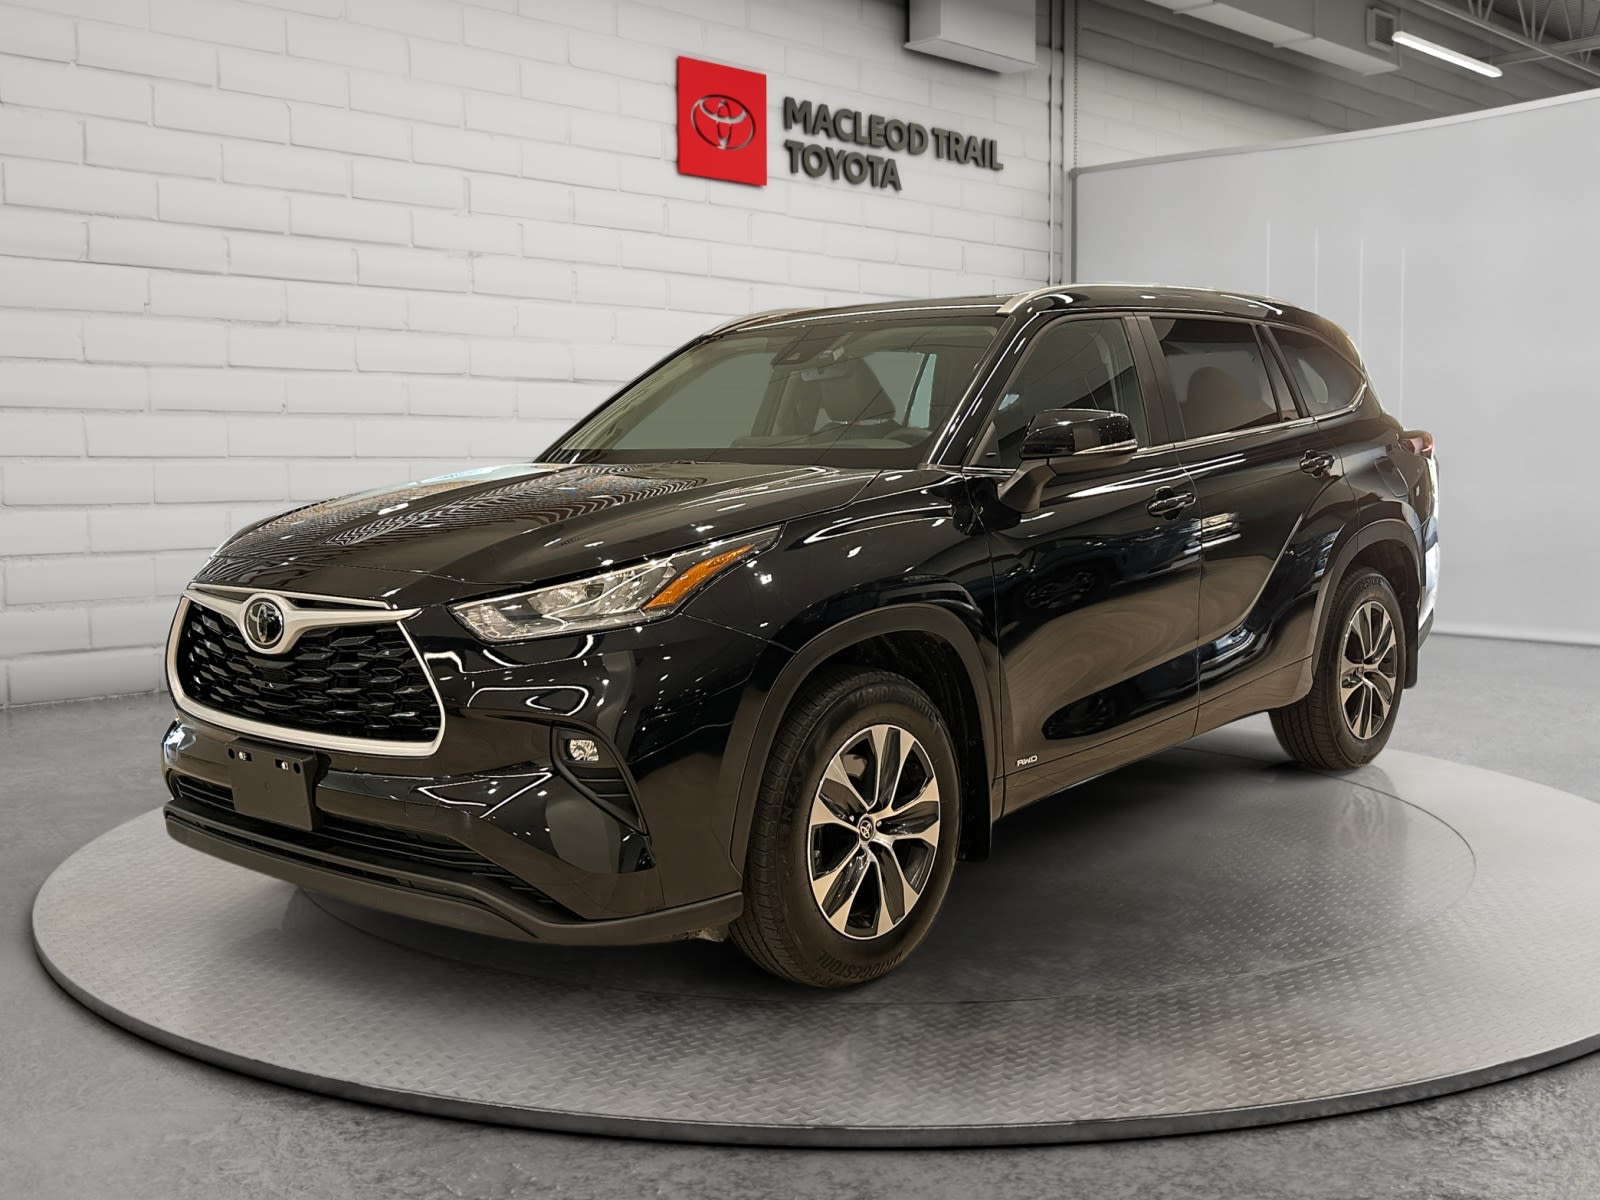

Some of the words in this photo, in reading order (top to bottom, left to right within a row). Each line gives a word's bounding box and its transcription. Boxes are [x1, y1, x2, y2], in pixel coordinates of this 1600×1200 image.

[783, 96, 929, 155] MACLEOD
[931, 127, 1004, 171] TRAIL
[785, 139, 902, 191] TOYOTA
[1016, 755, 1038, 767] AWD
